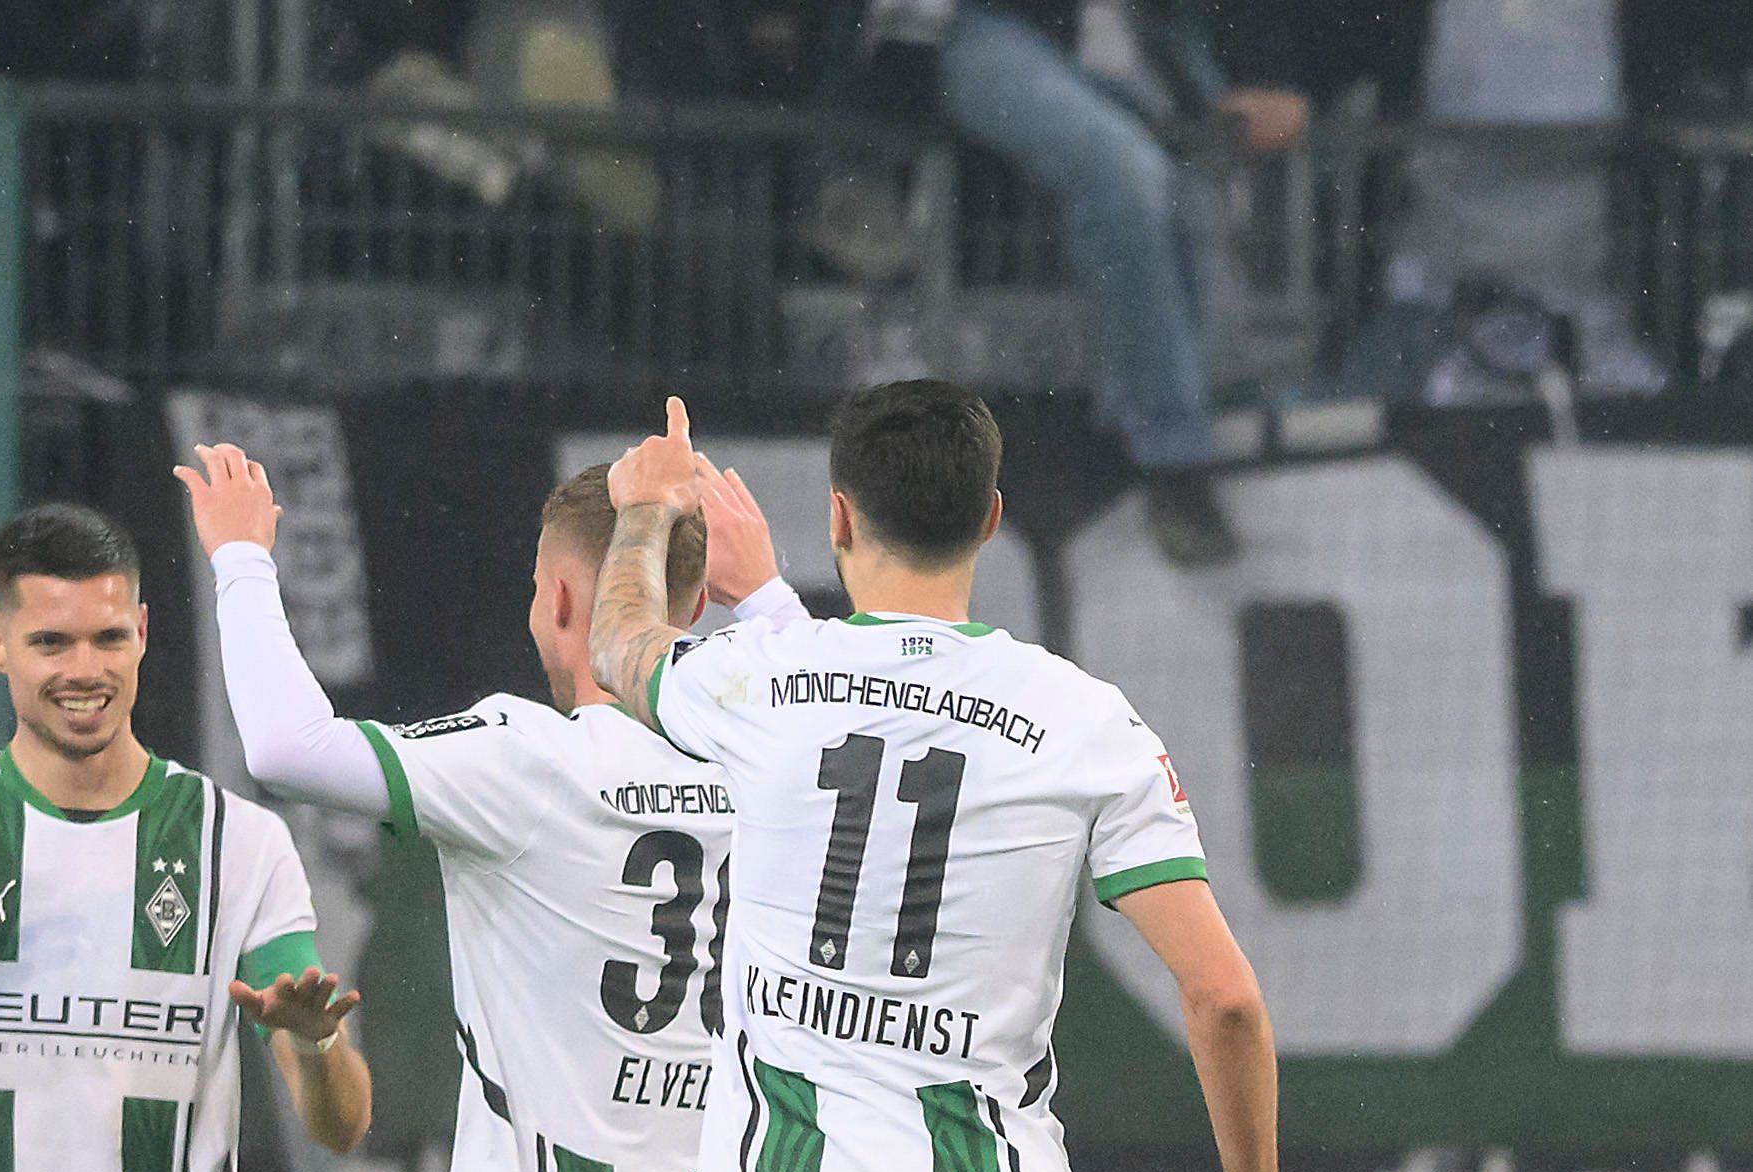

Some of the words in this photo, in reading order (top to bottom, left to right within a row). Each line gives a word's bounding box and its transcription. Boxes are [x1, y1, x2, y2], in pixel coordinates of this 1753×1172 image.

[901, 637, 933, 646] 1974
[901, 646, 933, 656] 1975
[771, 669, 1045, 753] MÖNCHENGLADBACH
[809, 733, 966, 978] 11
[747, 965, 979, 1059] KLEINDIENST
